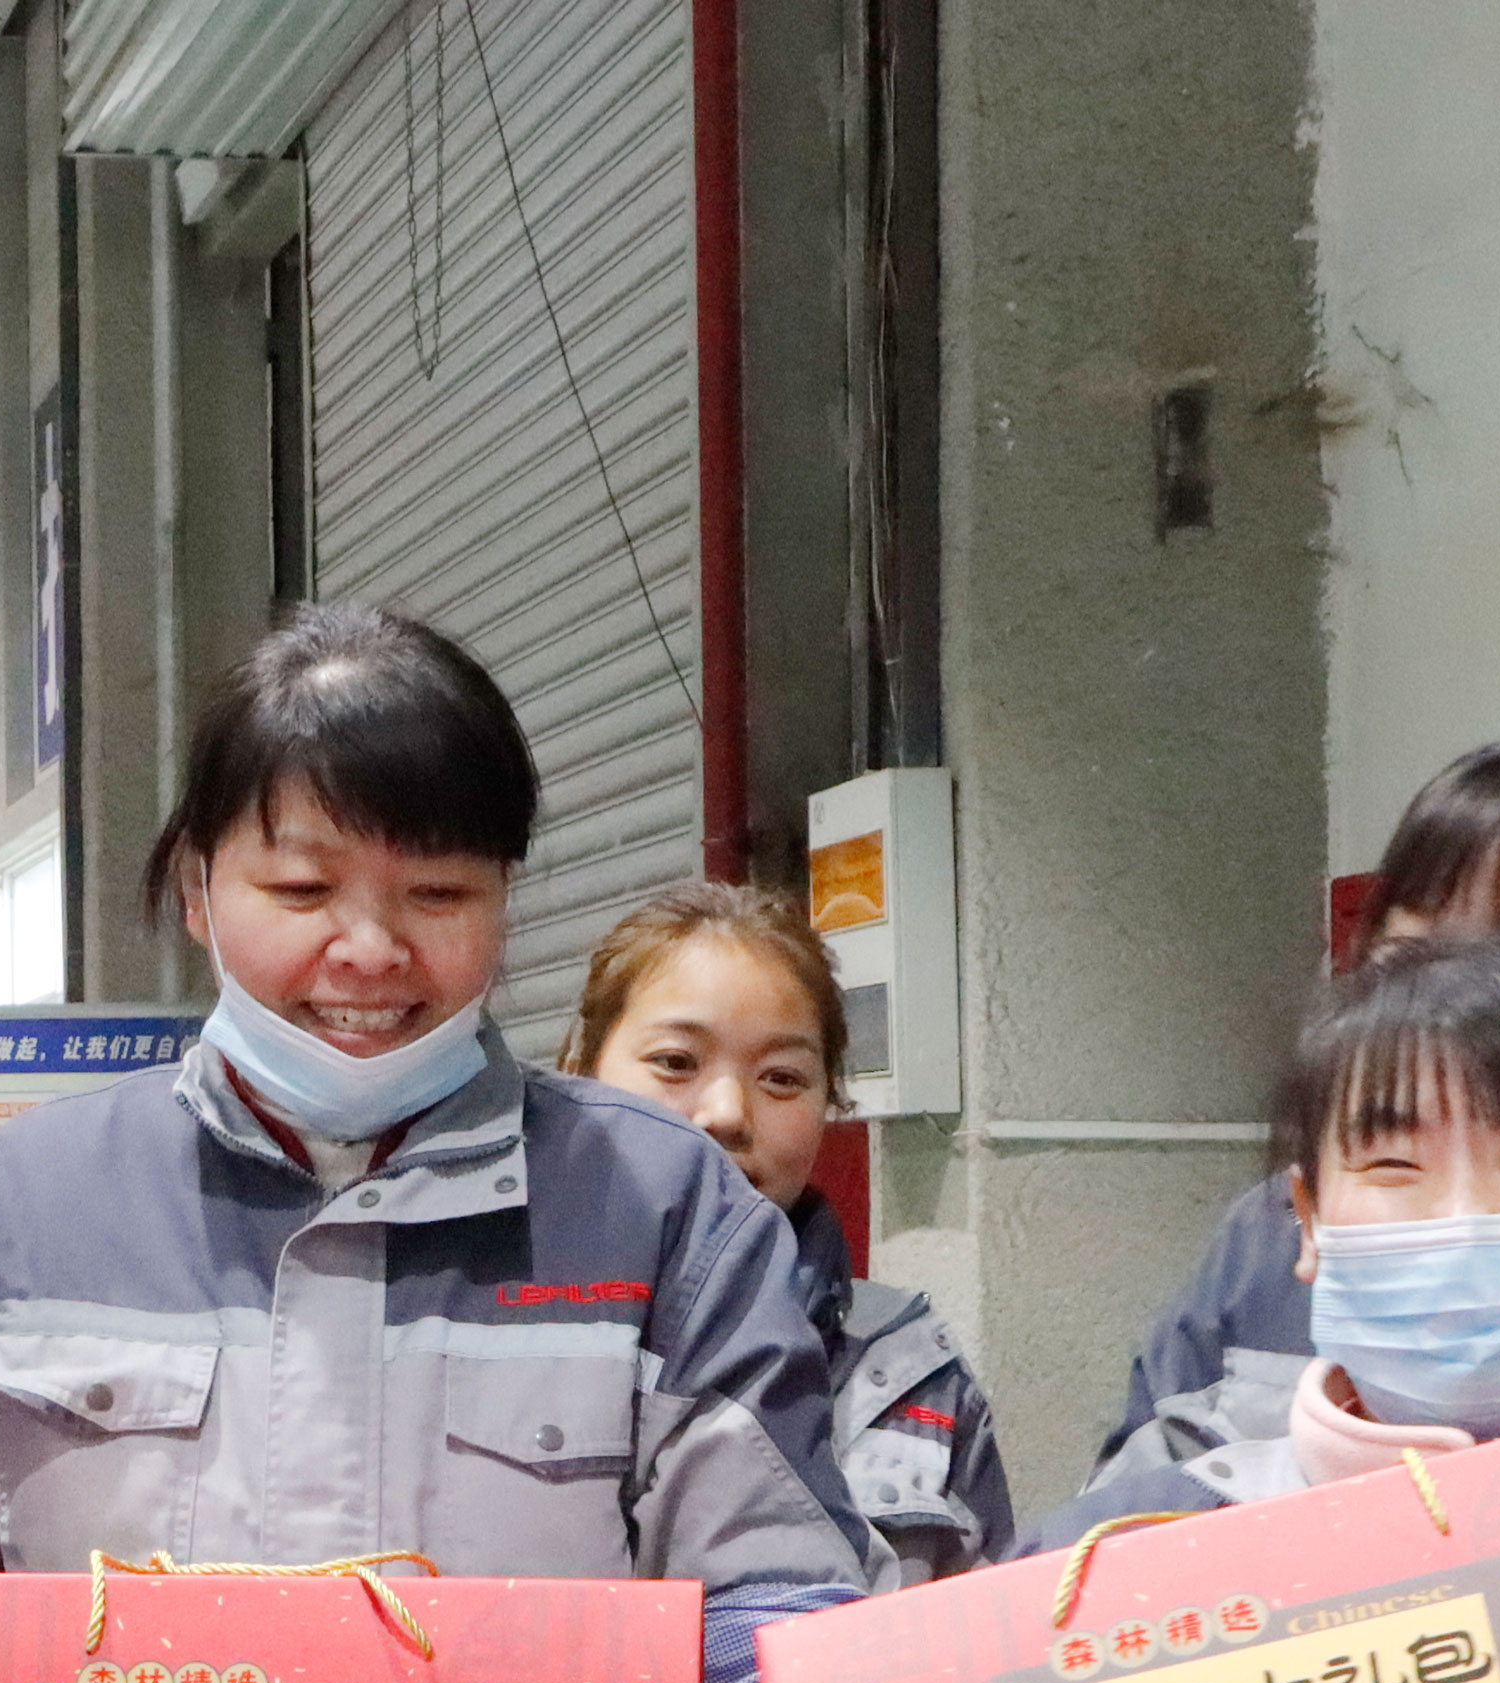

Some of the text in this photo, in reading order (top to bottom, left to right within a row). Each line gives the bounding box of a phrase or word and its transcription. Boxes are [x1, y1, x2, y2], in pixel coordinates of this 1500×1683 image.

[1061, 1599, 1260, 1672] 森林精选
[1286, 1583, 1455, 1637] Chinese
